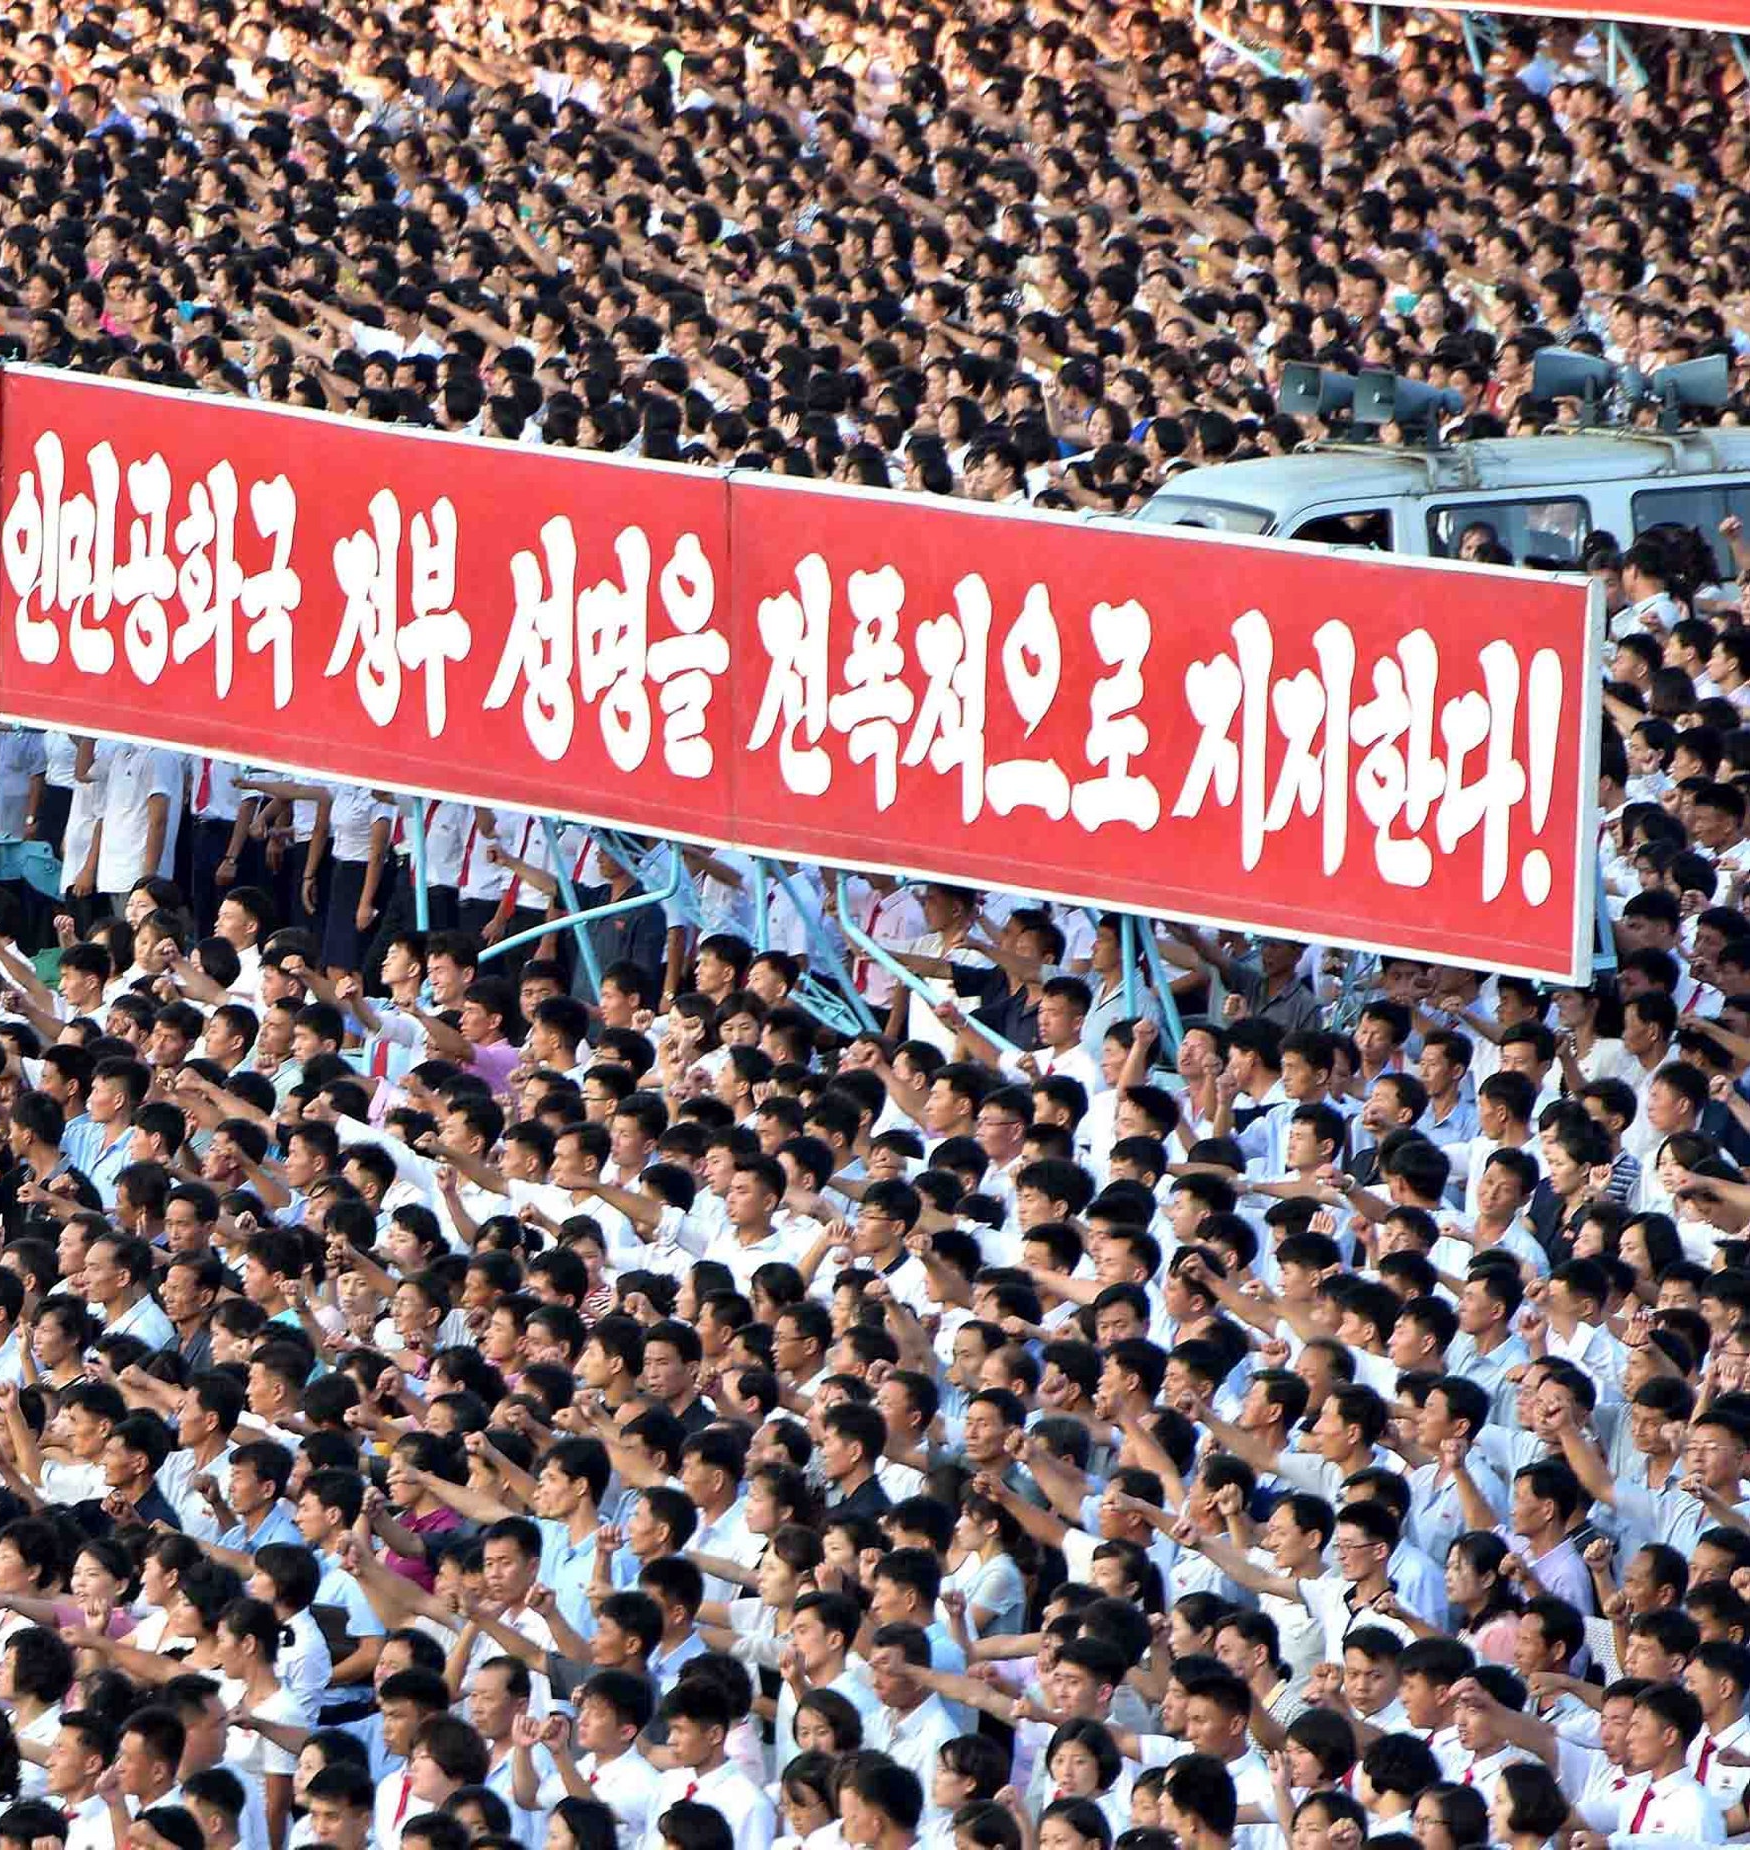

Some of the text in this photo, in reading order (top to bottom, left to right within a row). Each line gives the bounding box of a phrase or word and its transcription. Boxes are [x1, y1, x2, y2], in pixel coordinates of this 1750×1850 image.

[324, 487, 472, 739] 정부
[482, 514, 730, 780] 성명을
[746, 551, 1160, 833] 전폭적으로
[1171, 608, 1563, 908] 지지한다!
